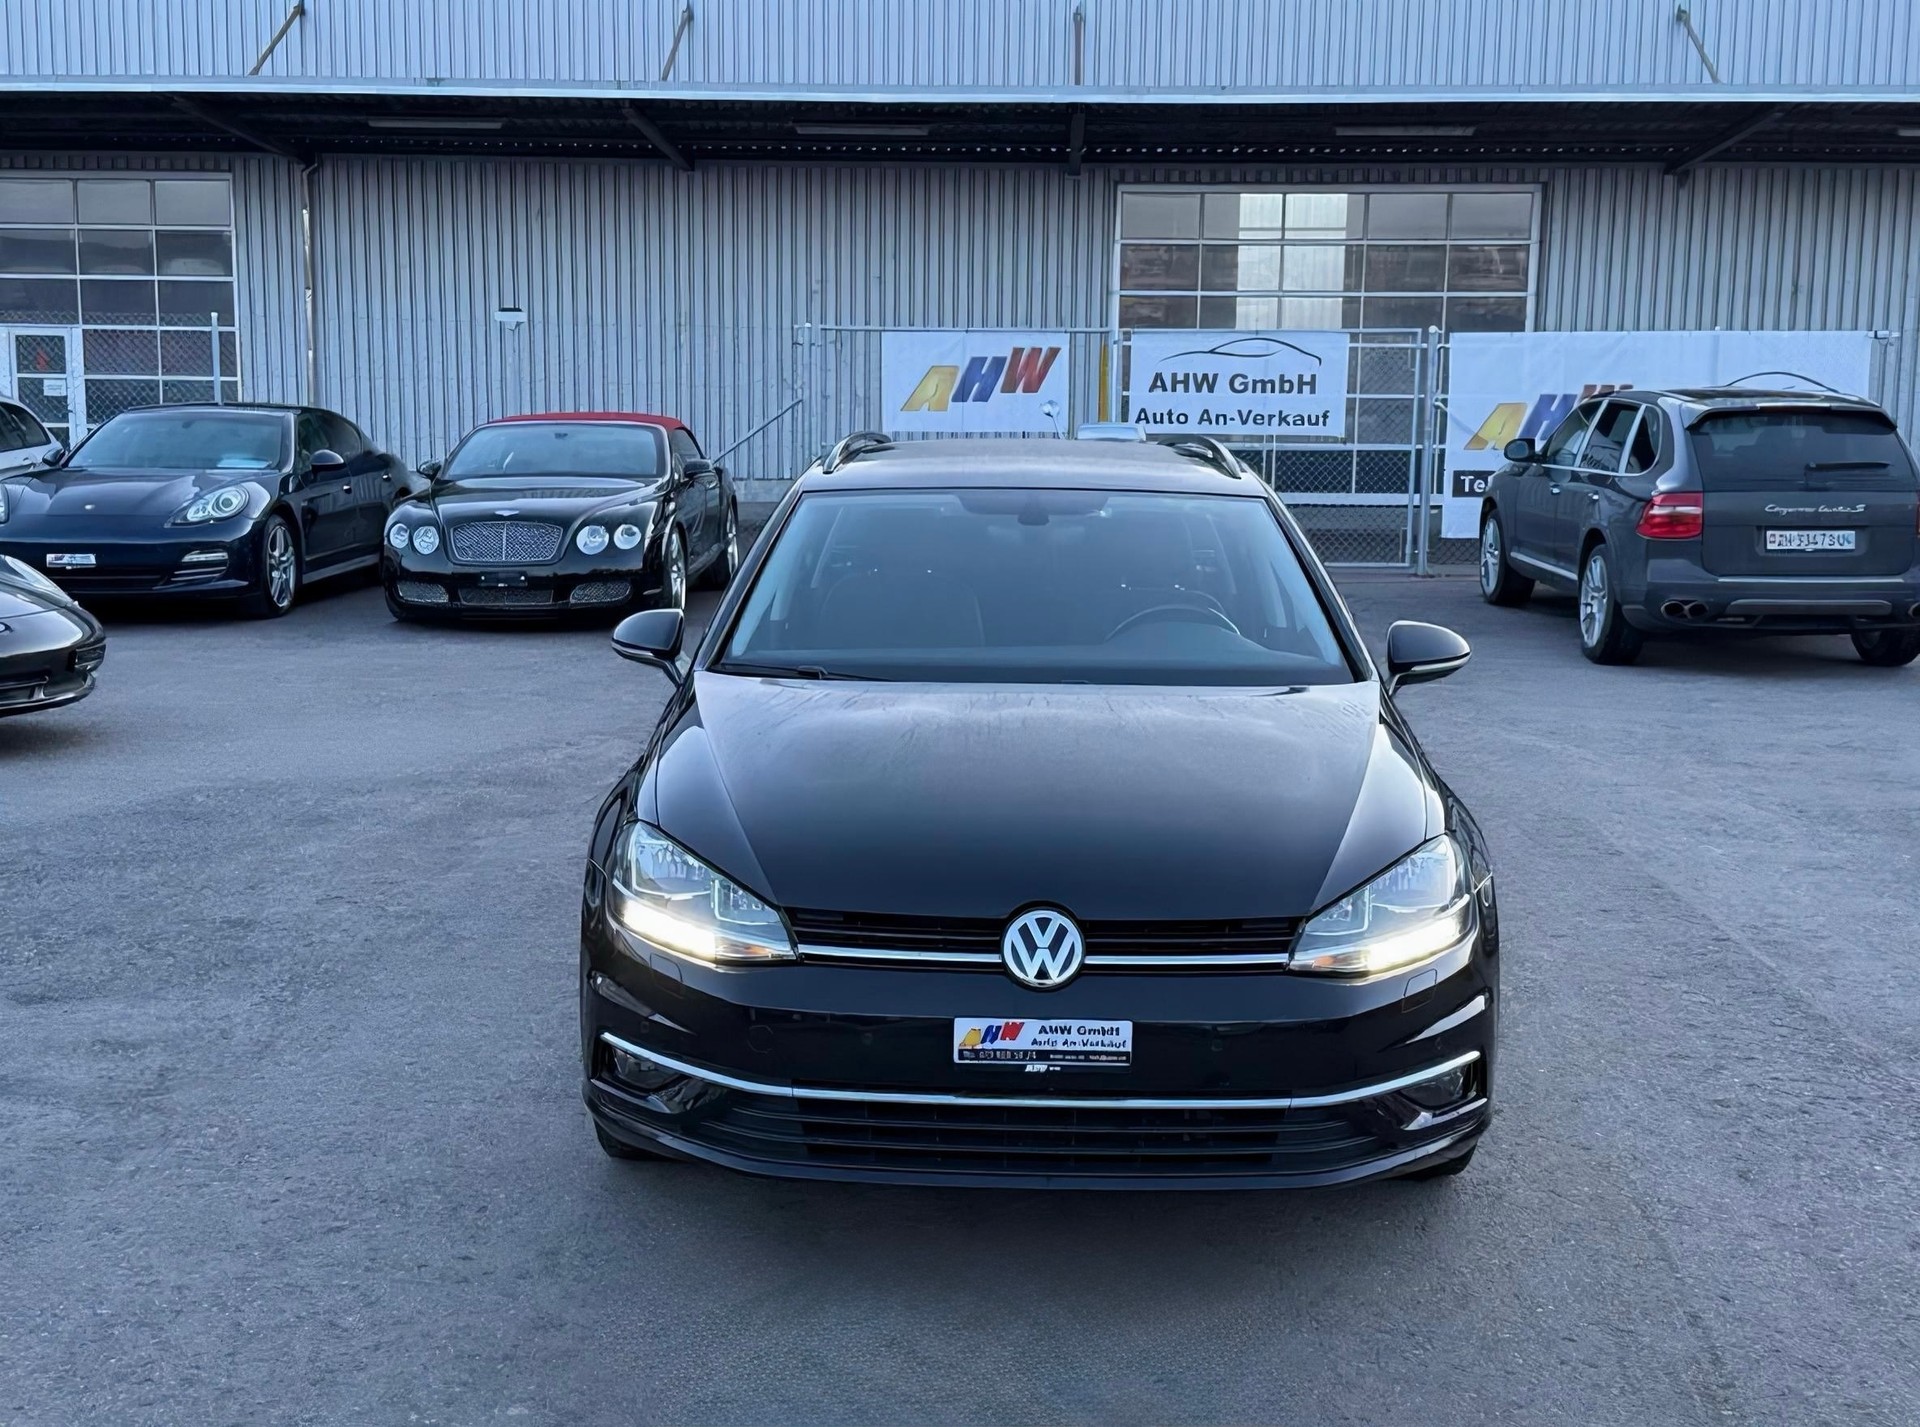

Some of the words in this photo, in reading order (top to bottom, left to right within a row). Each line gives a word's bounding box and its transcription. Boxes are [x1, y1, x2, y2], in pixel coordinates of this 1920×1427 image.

[900, 346, 1062, 412] AHW
[1148, 372, 1219, 394] AHW
[1228, 372, 1317, 395] GmbH
[1135, 407, 1189, 425] Auto
[1197, 408, 1331, 427] An-Verkauf
